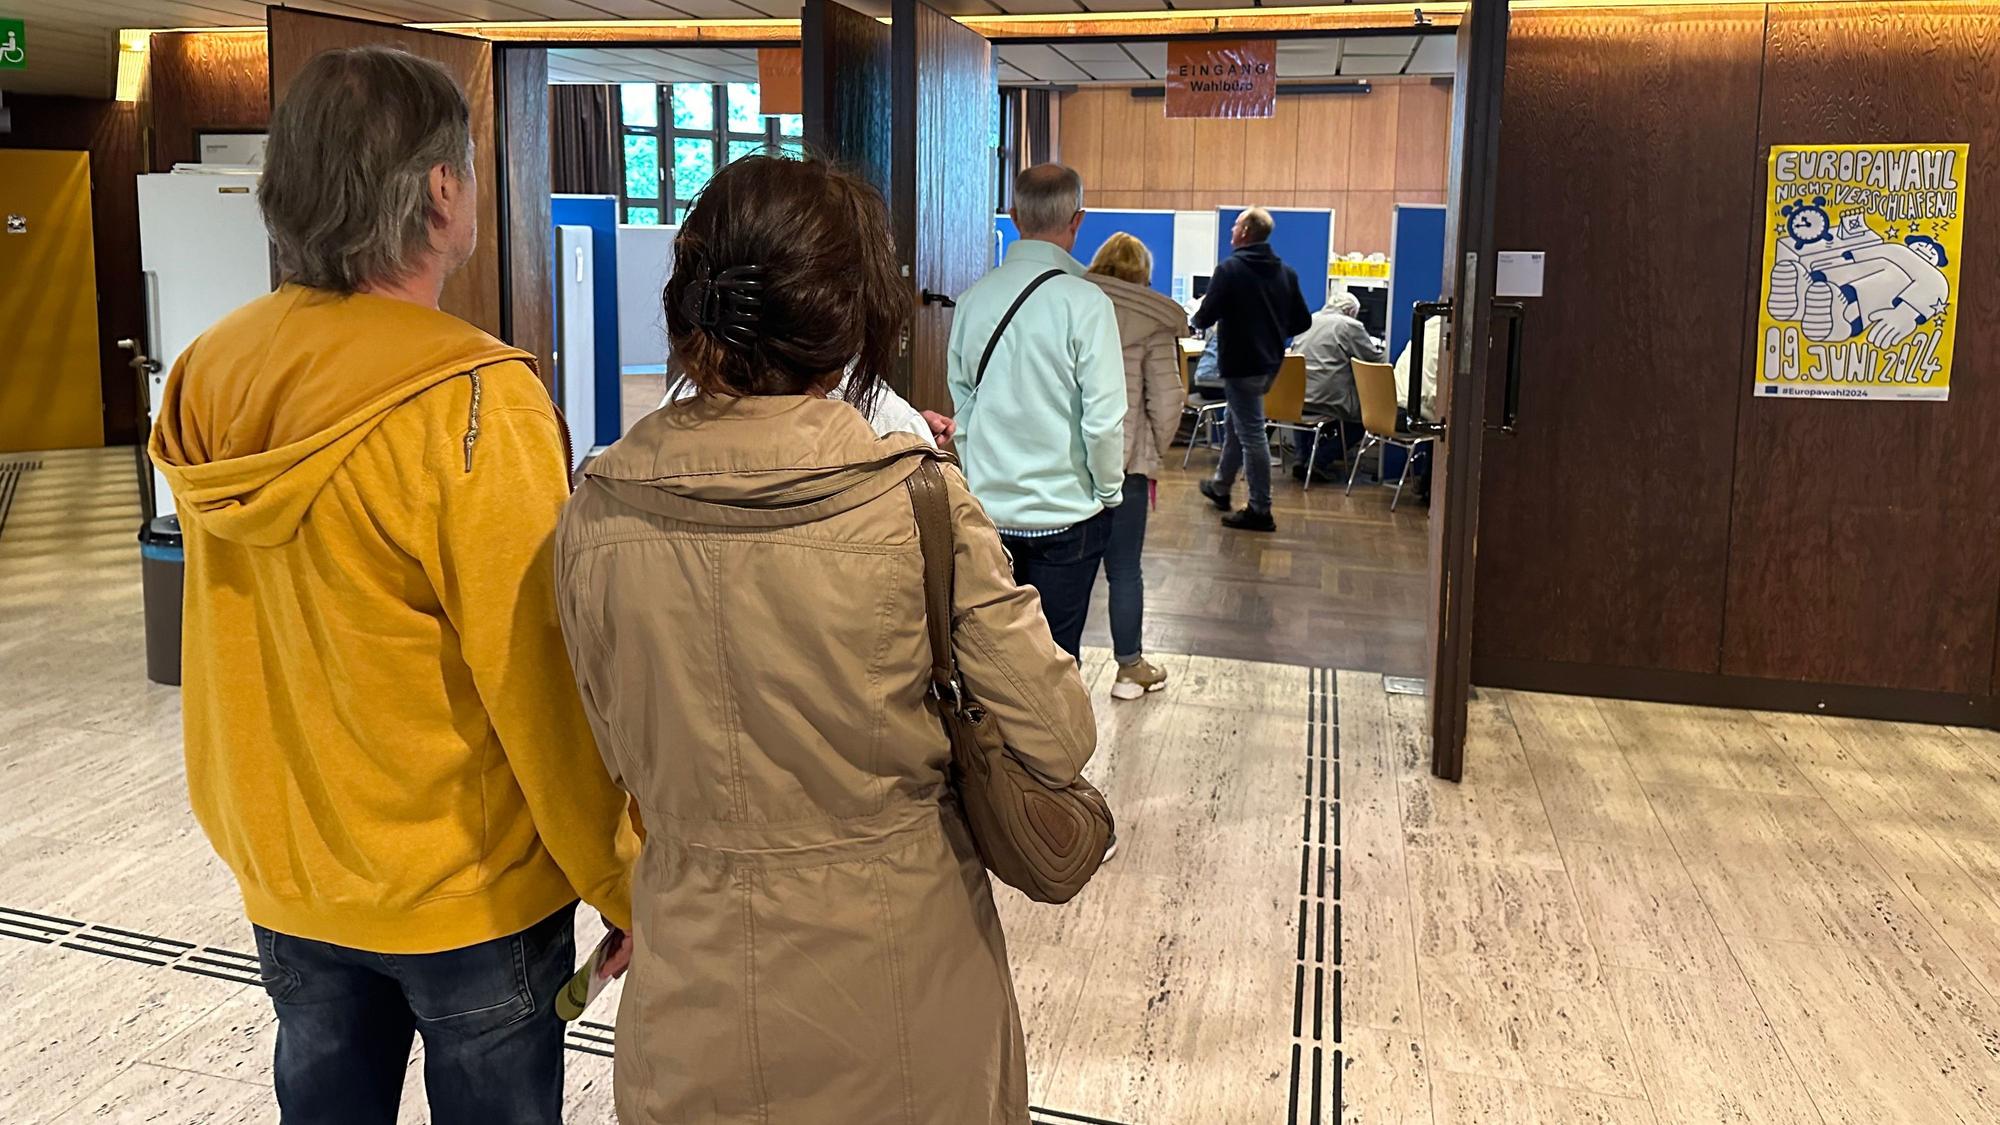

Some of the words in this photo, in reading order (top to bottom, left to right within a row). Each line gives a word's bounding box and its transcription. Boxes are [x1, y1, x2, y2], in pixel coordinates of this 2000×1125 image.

[1179, 63, 1267, 77] EINGANG
[1190, 81, 1254, 92] Wahlbüro
[1776, 151, 1958, 192] EUROPAWAHL
[1776, 182, 1832, 203] NICHT
[1834, 184, 1957, 222] VERSCHLAFEN!
[1878, 329, 1943, 383] 2024
[1782, 387, 1869, 398] #Europawahl2024
